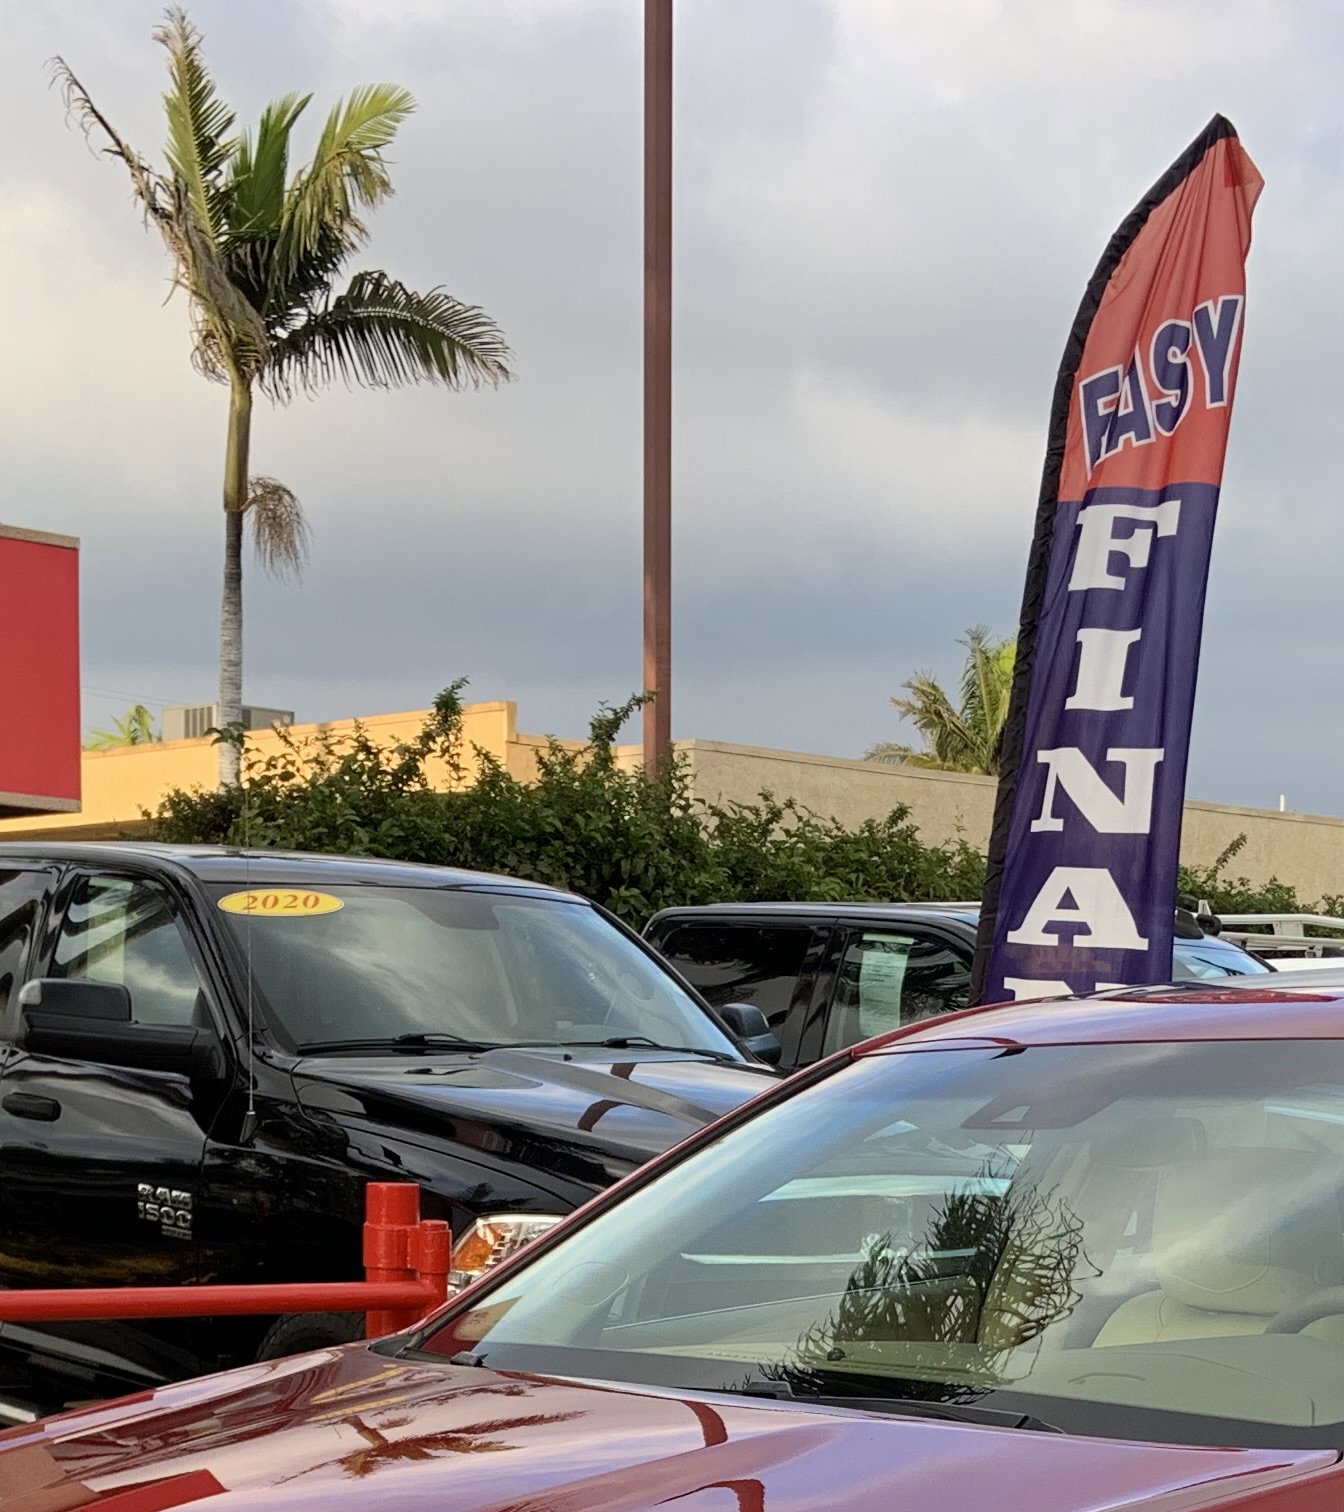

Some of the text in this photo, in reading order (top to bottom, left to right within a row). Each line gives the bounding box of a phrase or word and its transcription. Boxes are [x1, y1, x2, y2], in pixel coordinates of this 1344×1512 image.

[1079, 294, 1244, 478] EASY
[1003, 502, 1181, 1001] FINA
[241, 894, 320, 911] 2020
[137, 1183, 192, 1209] RAM
[137, 1201, 192, 1228] 1500
